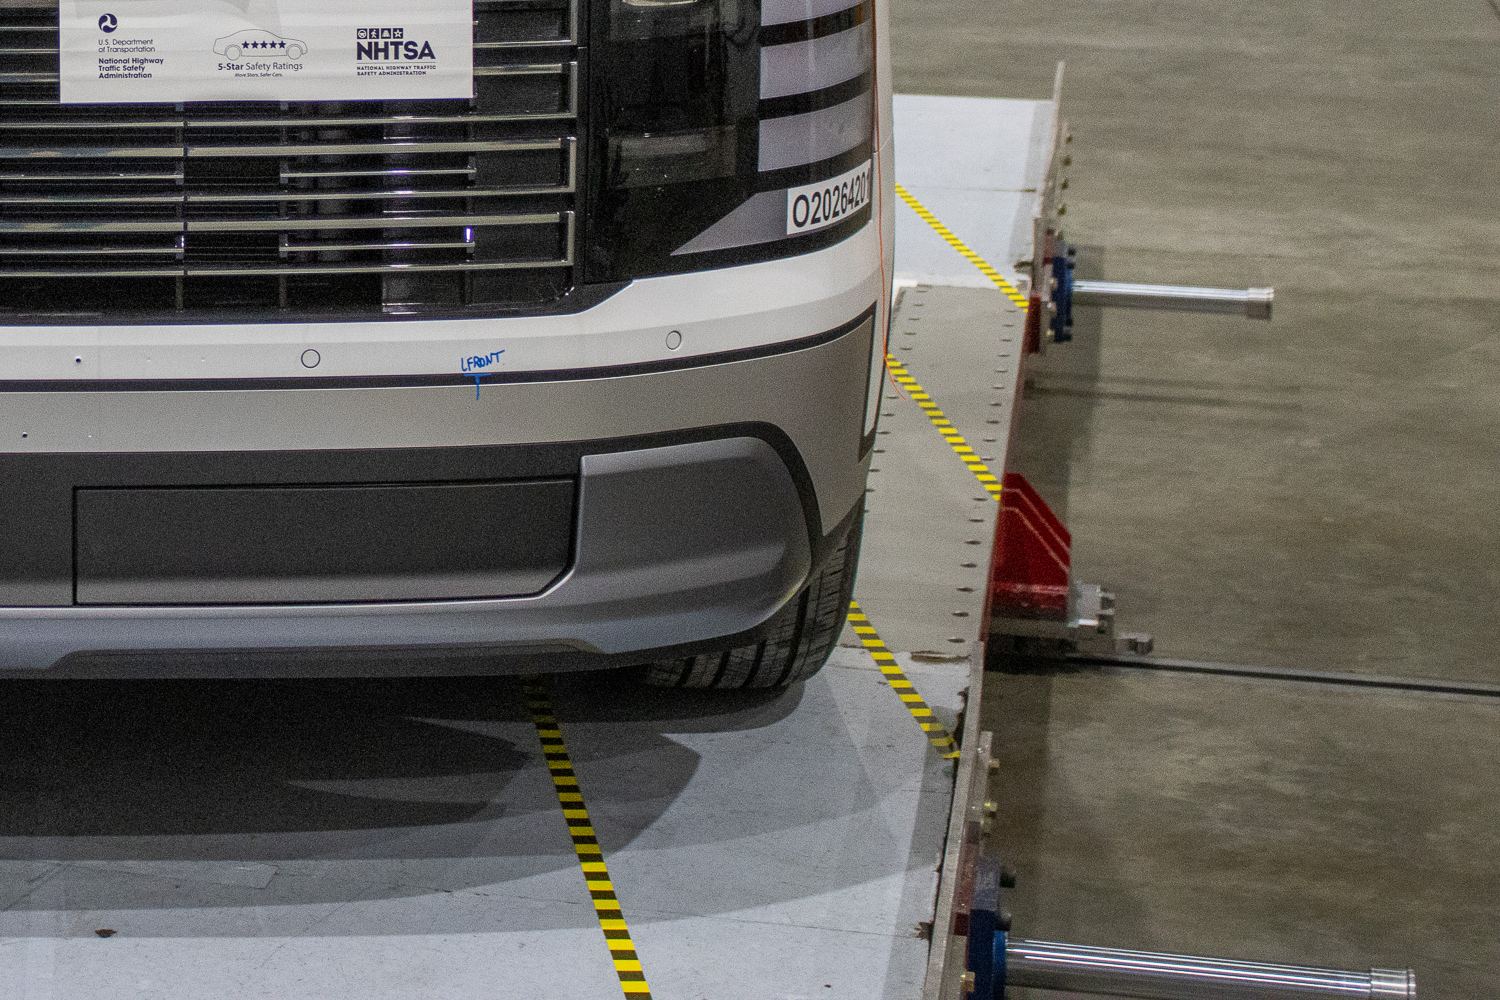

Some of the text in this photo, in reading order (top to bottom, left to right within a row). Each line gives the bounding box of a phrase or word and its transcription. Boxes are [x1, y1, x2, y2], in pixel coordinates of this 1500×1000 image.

[112, 38, 154, 47] Department
[106, 46, 156, 54] Transportation
[356, 40, 436, 61] NHTSA
[98, 57, 164, 66] National Highway
[122, 65, 146, 73] Safety
[217, 62, 303, 72] 5-Star Safety Ratings
[461, 349, 506, 372] LFRONT
